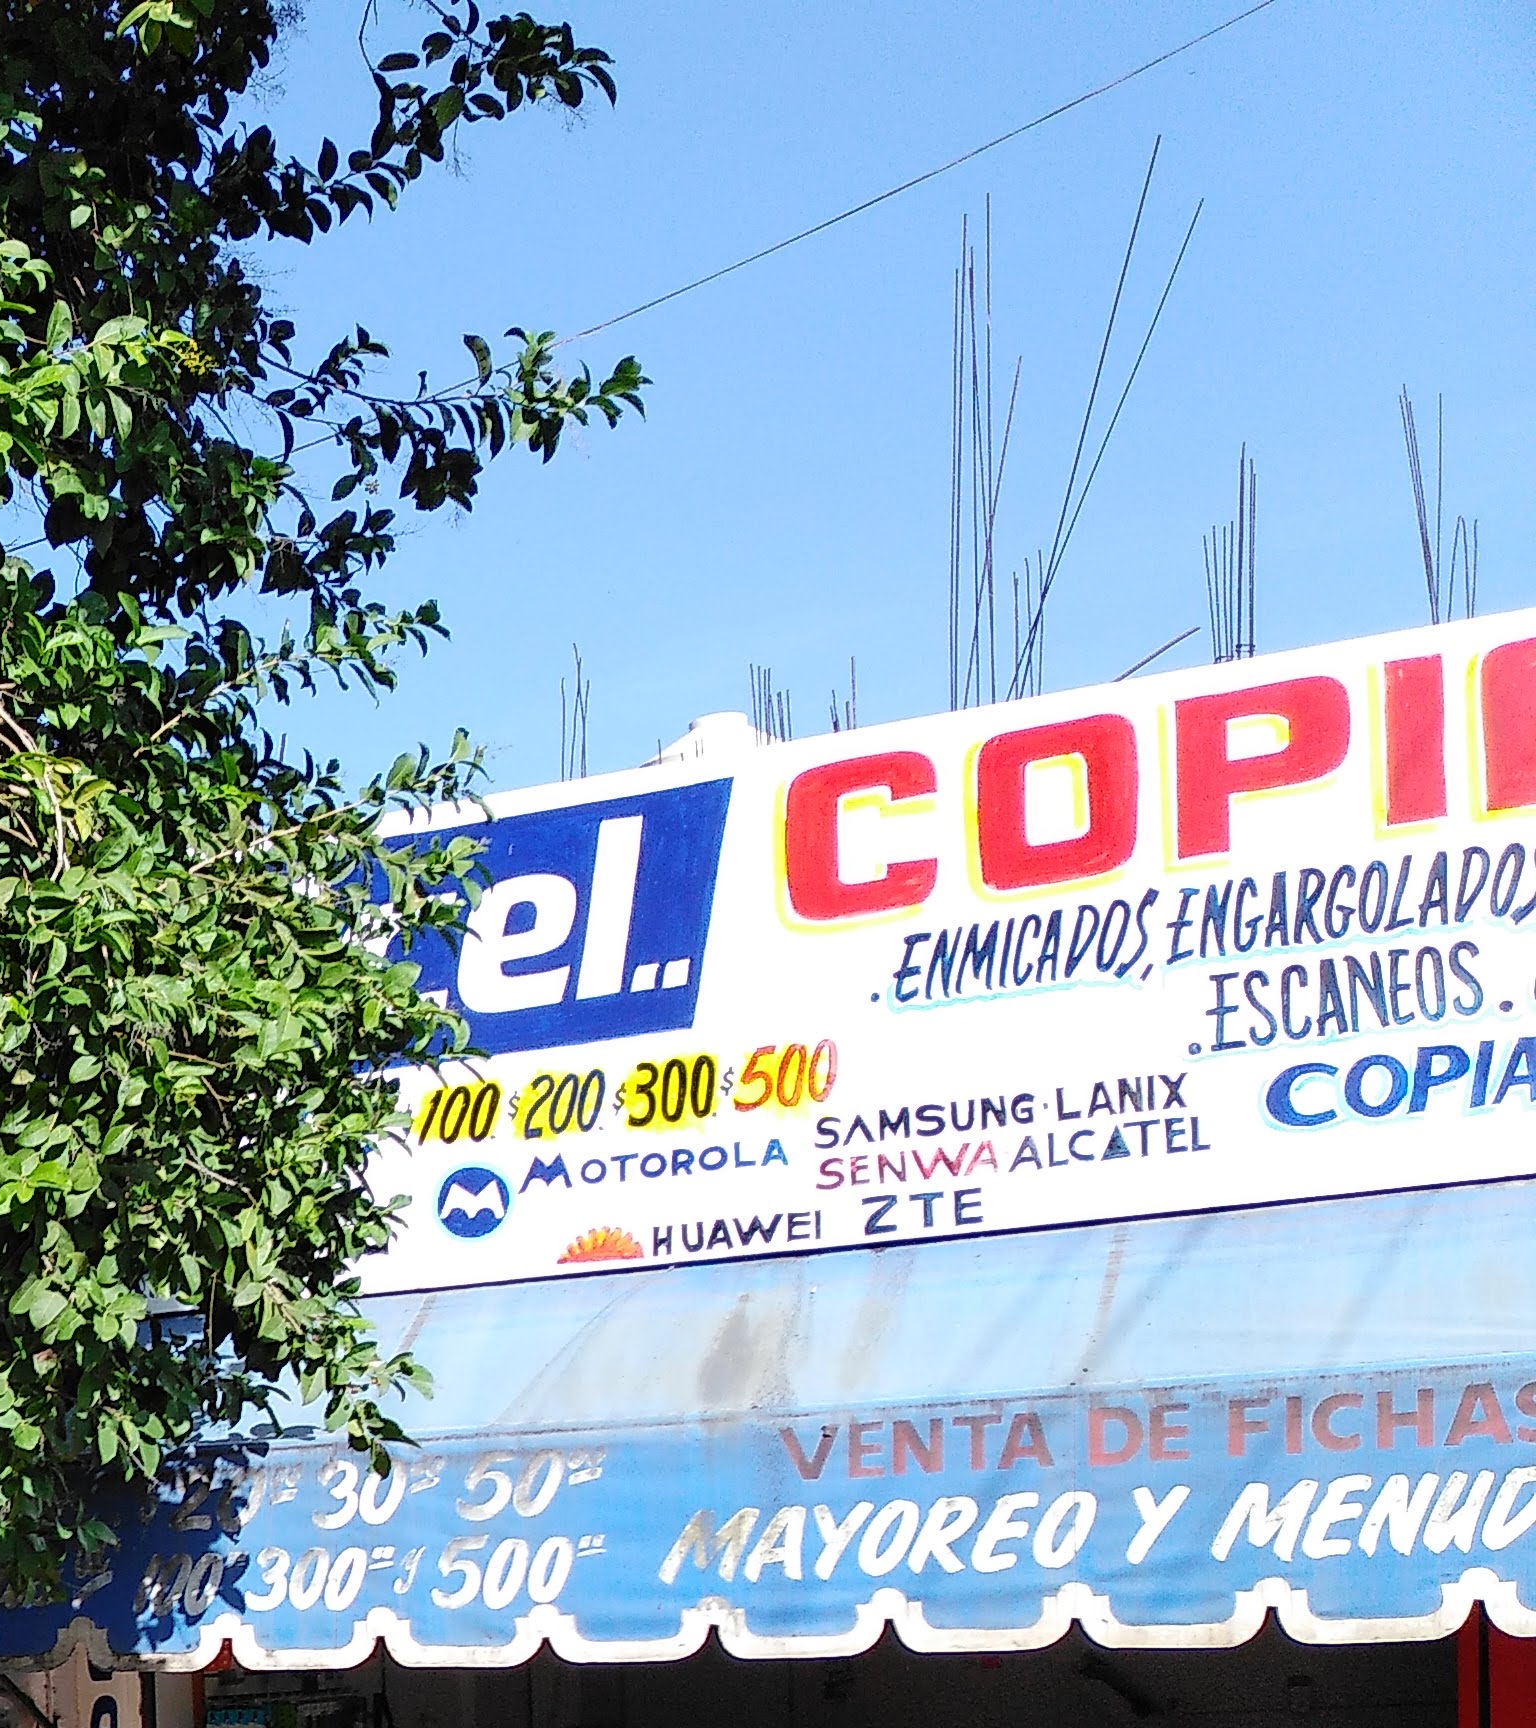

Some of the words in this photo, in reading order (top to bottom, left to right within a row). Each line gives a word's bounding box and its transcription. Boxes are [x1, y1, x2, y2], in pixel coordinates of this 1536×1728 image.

[518, 1138, 789, 1194] MOTOROLA
[815, 1140, 998, 1190] SENWA
[1008, 1116, 1212, 1173] ALCATEL
[652, 1209, 822, 1258] HUAWEI
[861, 1187, 984, 1236] ZTE
[778, 1408, 1056, 1482] VENTA
[1086, 1400, 1192, 1468] DE
[657, 1490, 1098, 1586] MAYOREO
[1123, 1484, 1192, 1566] Y
